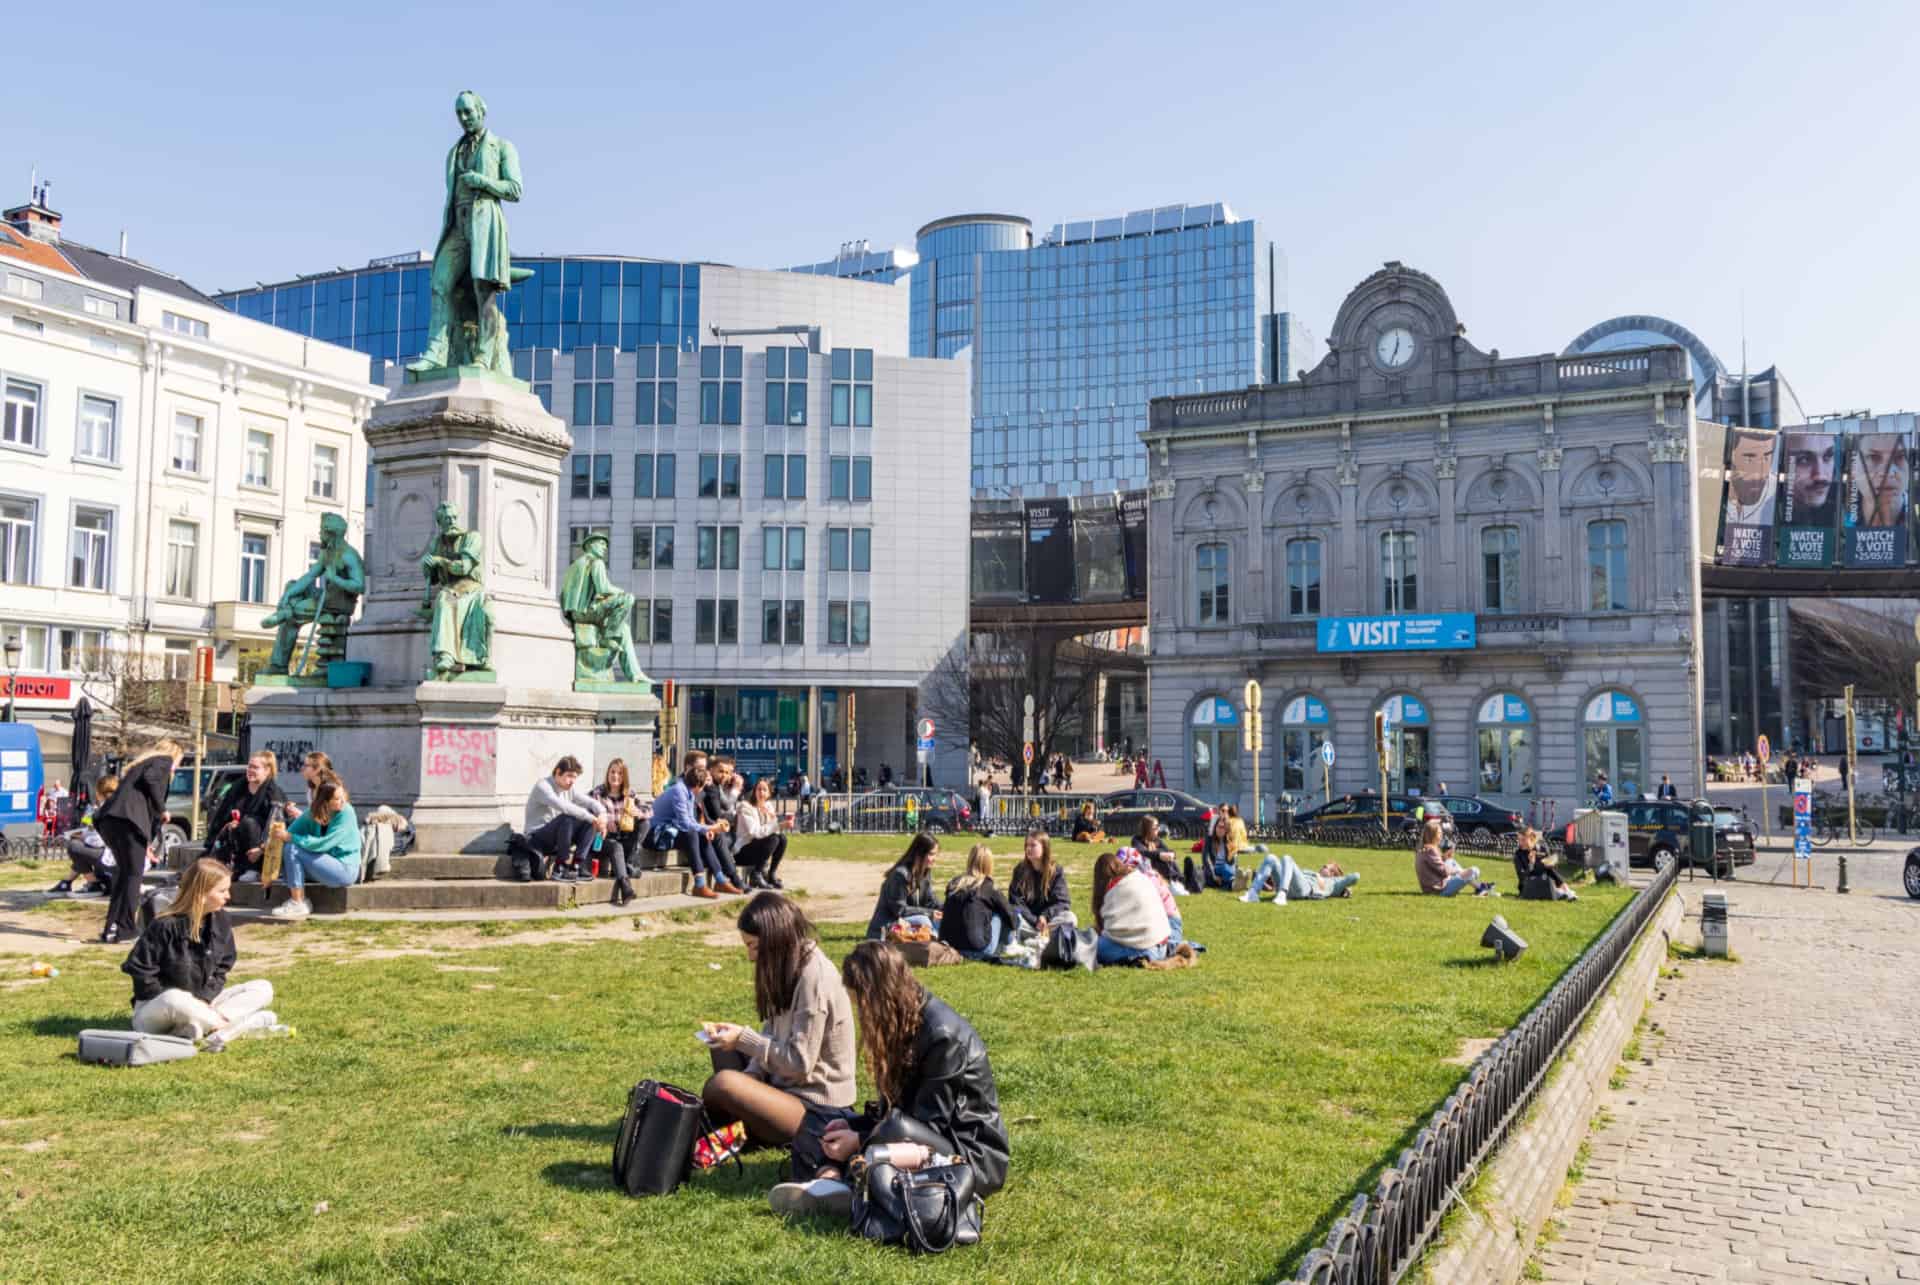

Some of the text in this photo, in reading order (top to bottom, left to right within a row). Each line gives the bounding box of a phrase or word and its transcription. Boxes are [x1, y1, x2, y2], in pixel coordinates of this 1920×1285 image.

[1029, 508, 1050, 518] VISIT
[1733, 528, 1762, 539] WATCH
[1790, 531, 1824, 542] WATCH
[1855, 530, 1894, 542] WATCH
[1740, 539, 1761, 551] VOTE
[1799, 542, 1823, 552] VOTE
[1867, 541, 1894, 552] VOTE
[1347, 621, 1400, 646] VISIT
[653, 736, 793, 752] pamentarium
